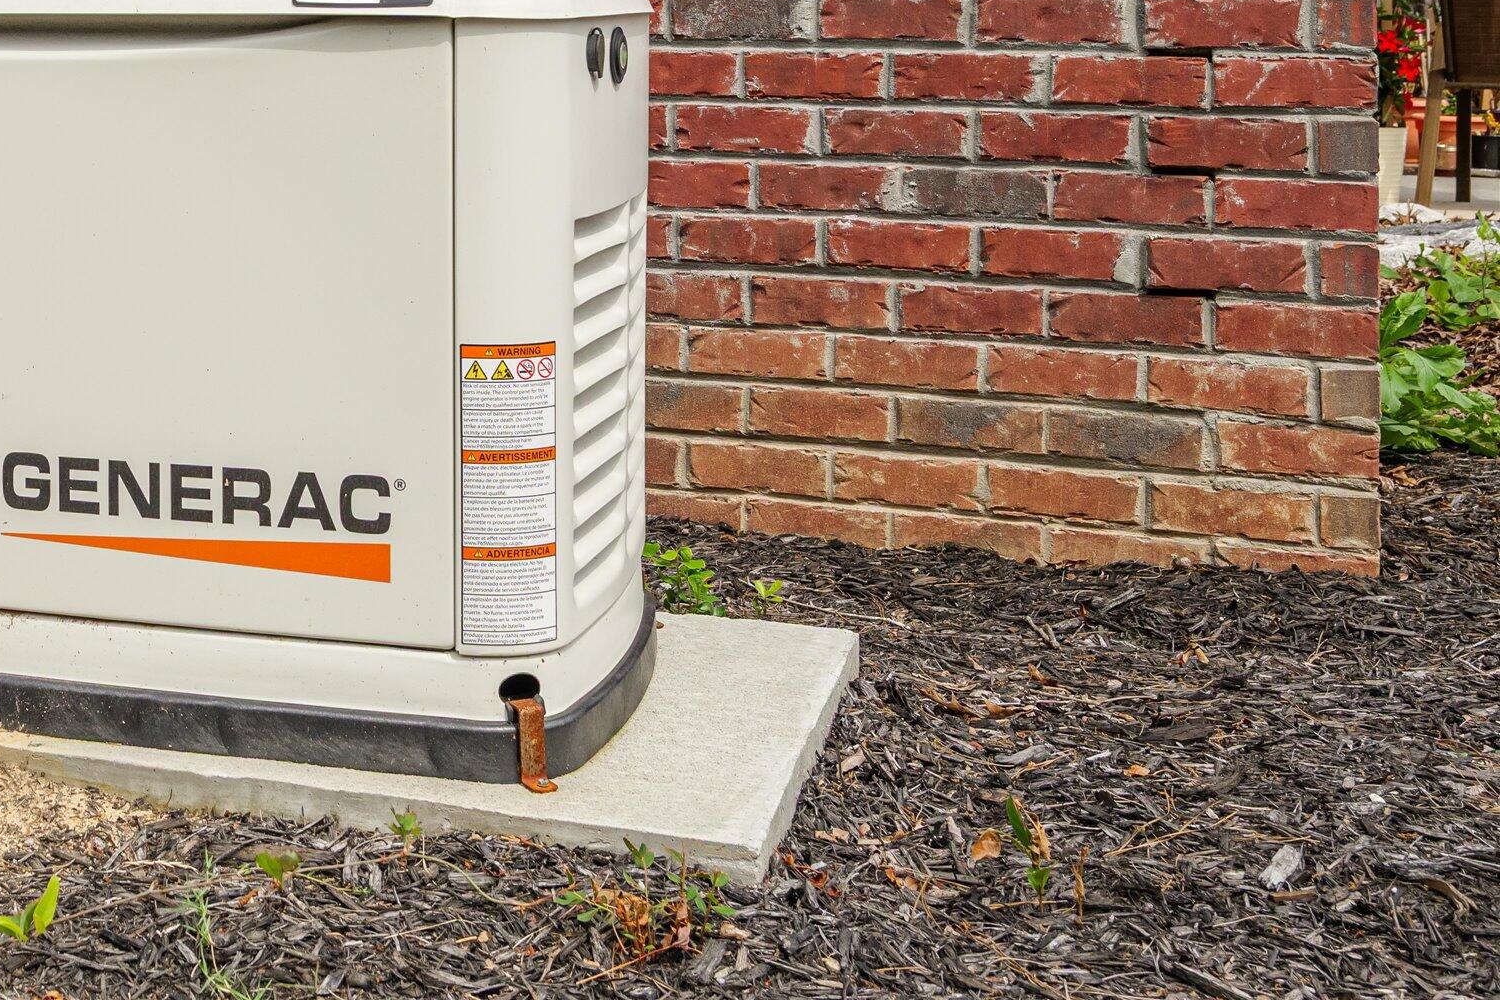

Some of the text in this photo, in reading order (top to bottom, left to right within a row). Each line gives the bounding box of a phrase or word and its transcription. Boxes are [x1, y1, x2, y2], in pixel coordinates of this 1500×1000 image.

[498, 347, 541, 356] WARNING
[479, 449, 553, 461] AVERTISSEMENT
[486, 547, 550, 558] ADVERTENCIA
